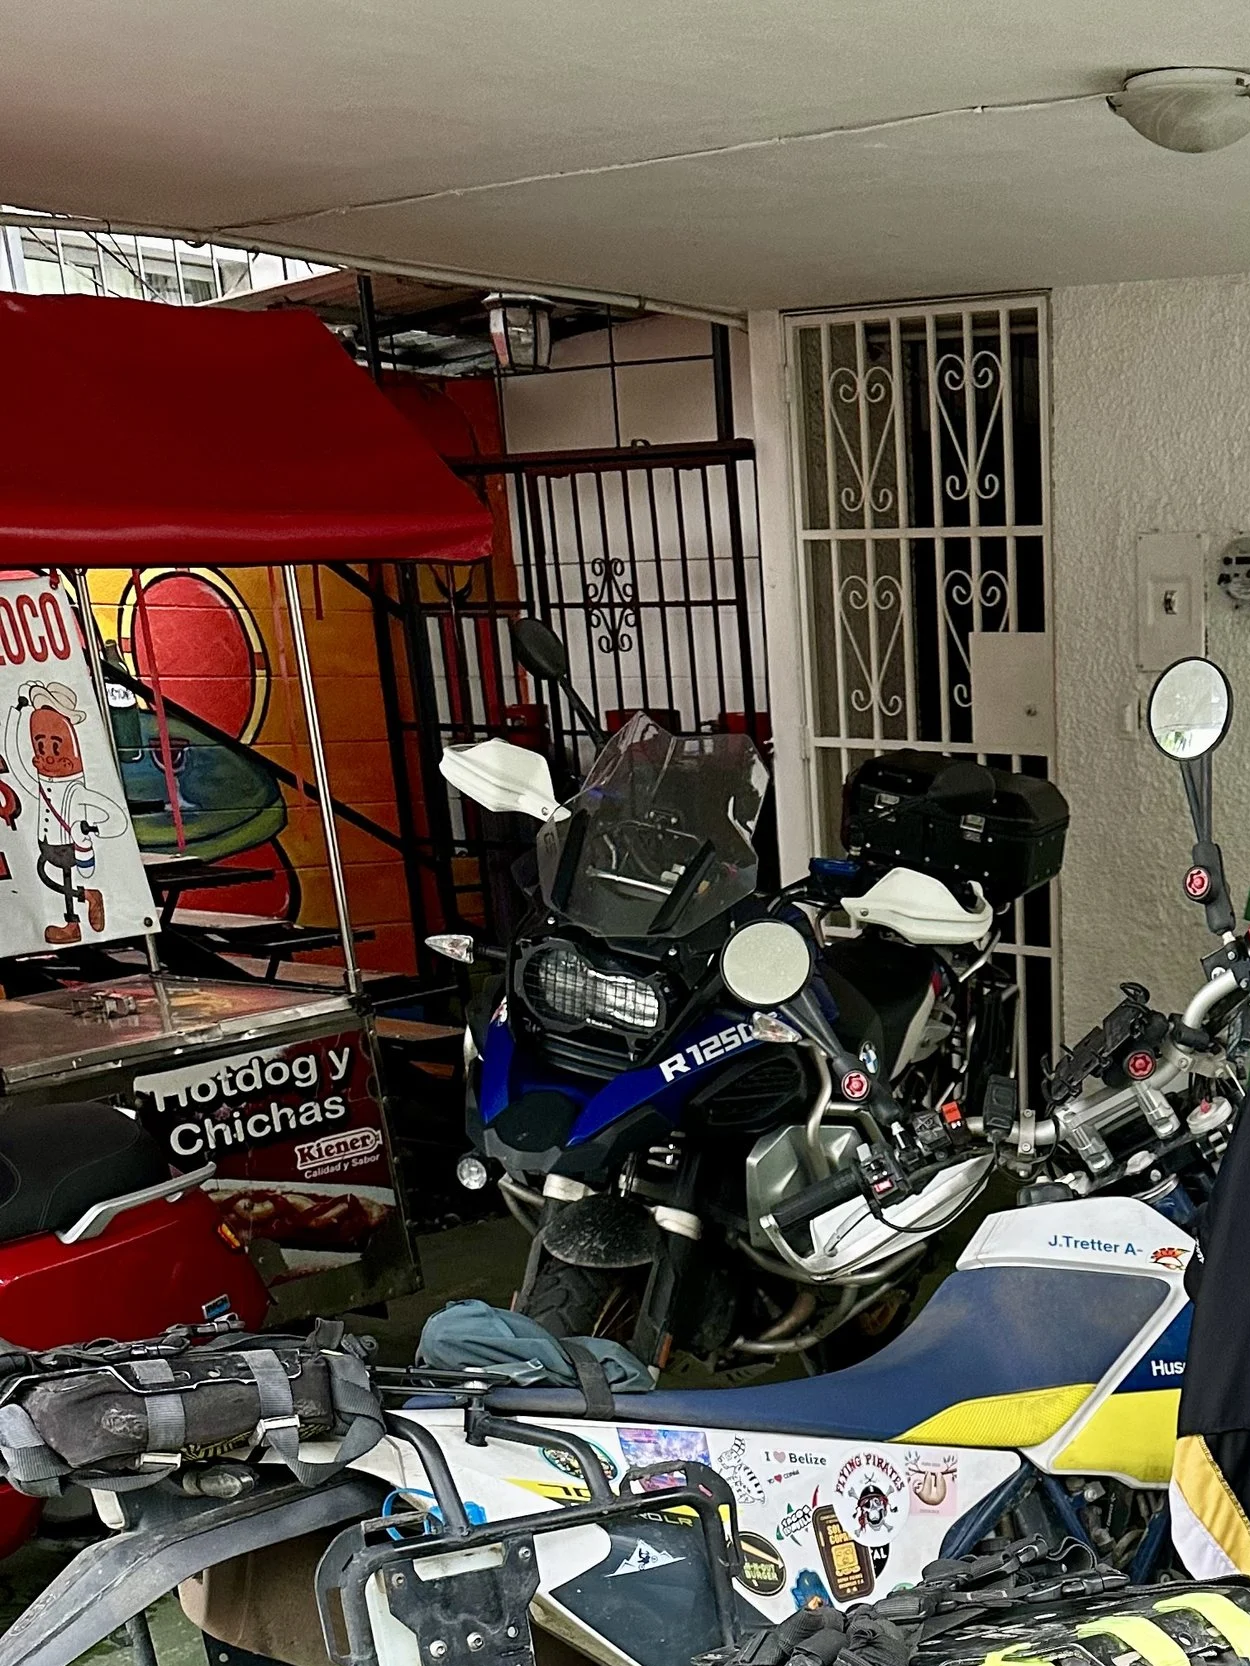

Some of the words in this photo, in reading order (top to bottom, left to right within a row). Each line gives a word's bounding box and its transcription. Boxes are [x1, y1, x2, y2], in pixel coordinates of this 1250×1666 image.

[0, 591, 71, 666] OCO
[327, 1047, 350, 1081] y
[659, 1052, 691, 1082] R
[169, 1095, 346, 1156] Chichas
[297, 1133, 371, 1164] Kiener
[304, 1162, 341, 1179] Calidad
[351, 1154, 380, 1168] Sabor
[764, 1451, 771, 1462] I
[788, 1452, 827, 1466] Belize
[833, 1455, 862, 1496] FLYING
[864, 1453, 905, 1492] PIRATES
